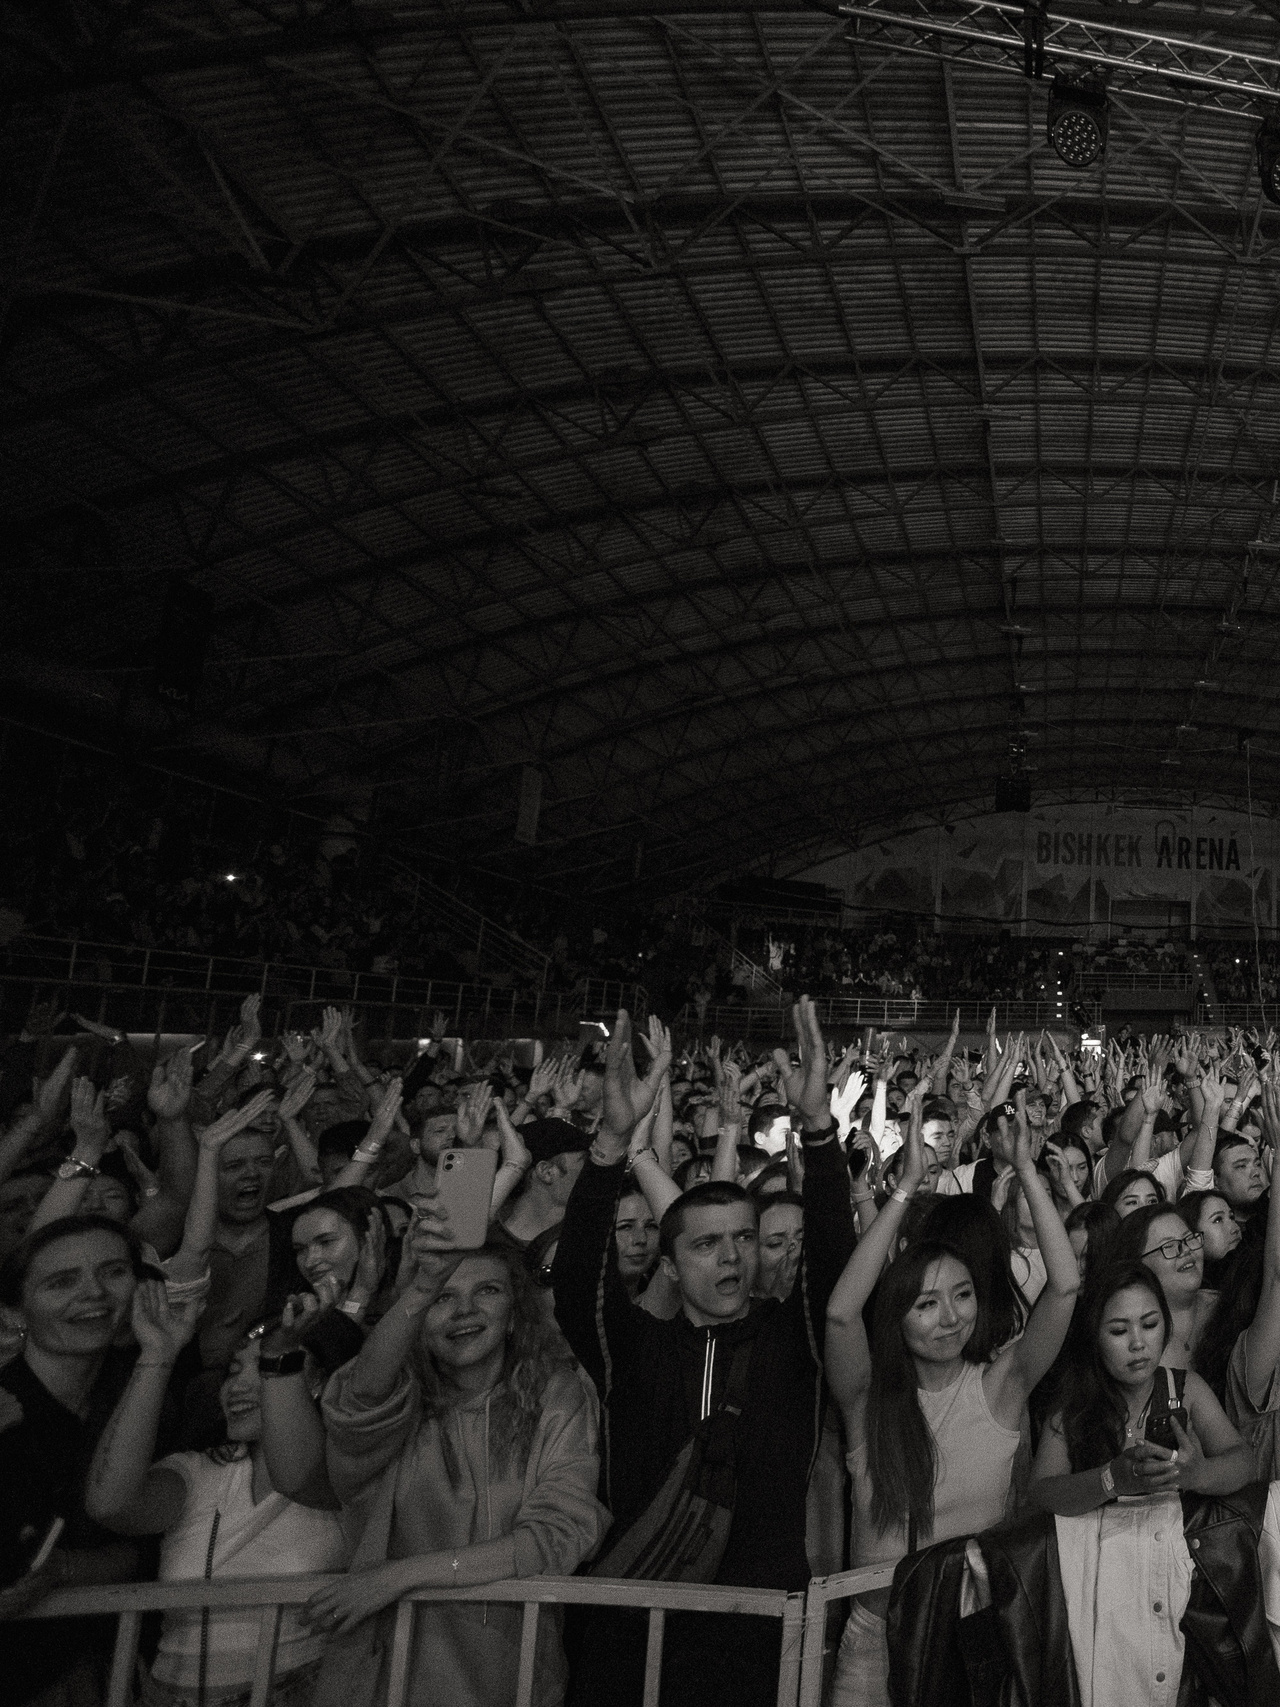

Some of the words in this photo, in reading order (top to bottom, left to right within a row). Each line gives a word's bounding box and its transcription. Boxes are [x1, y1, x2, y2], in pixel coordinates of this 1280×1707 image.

[1036, 831, 1142, 868] BISHKEK
[1157, 835, 1240, 871] ARENA
[1003, 1104, 1015, 1115] LA
